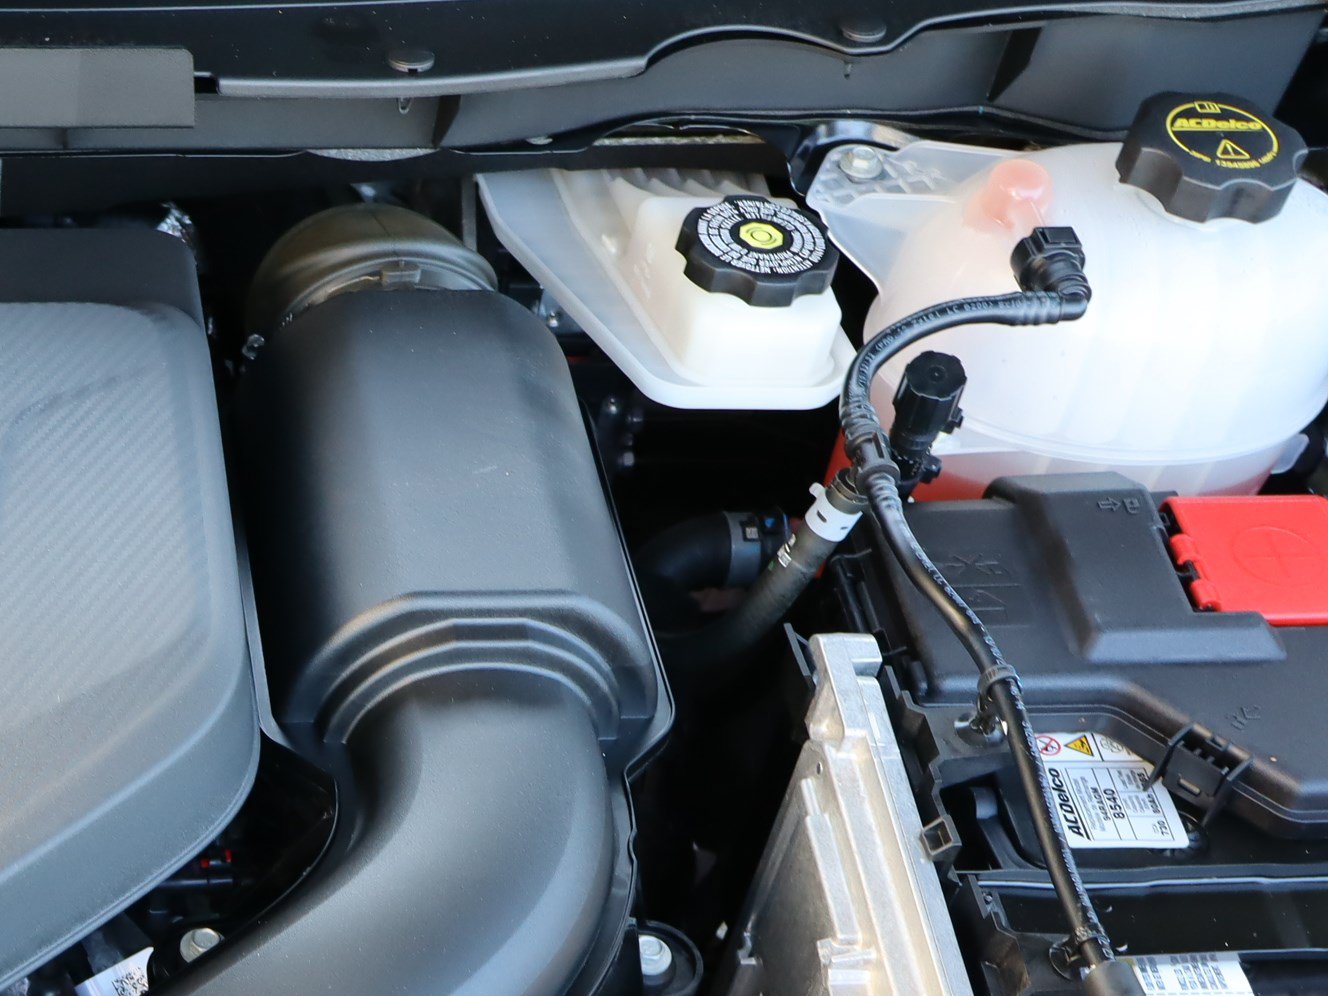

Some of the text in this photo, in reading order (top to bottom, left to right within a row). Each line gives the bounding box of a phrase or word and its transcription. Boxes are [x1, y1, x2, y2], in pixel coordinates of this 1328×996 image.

[1173, 117, 1263, 131] ACDelco
[1048, 767, 1085, 838] ACDelco
[1103, 788, 1126, 819] 8540
